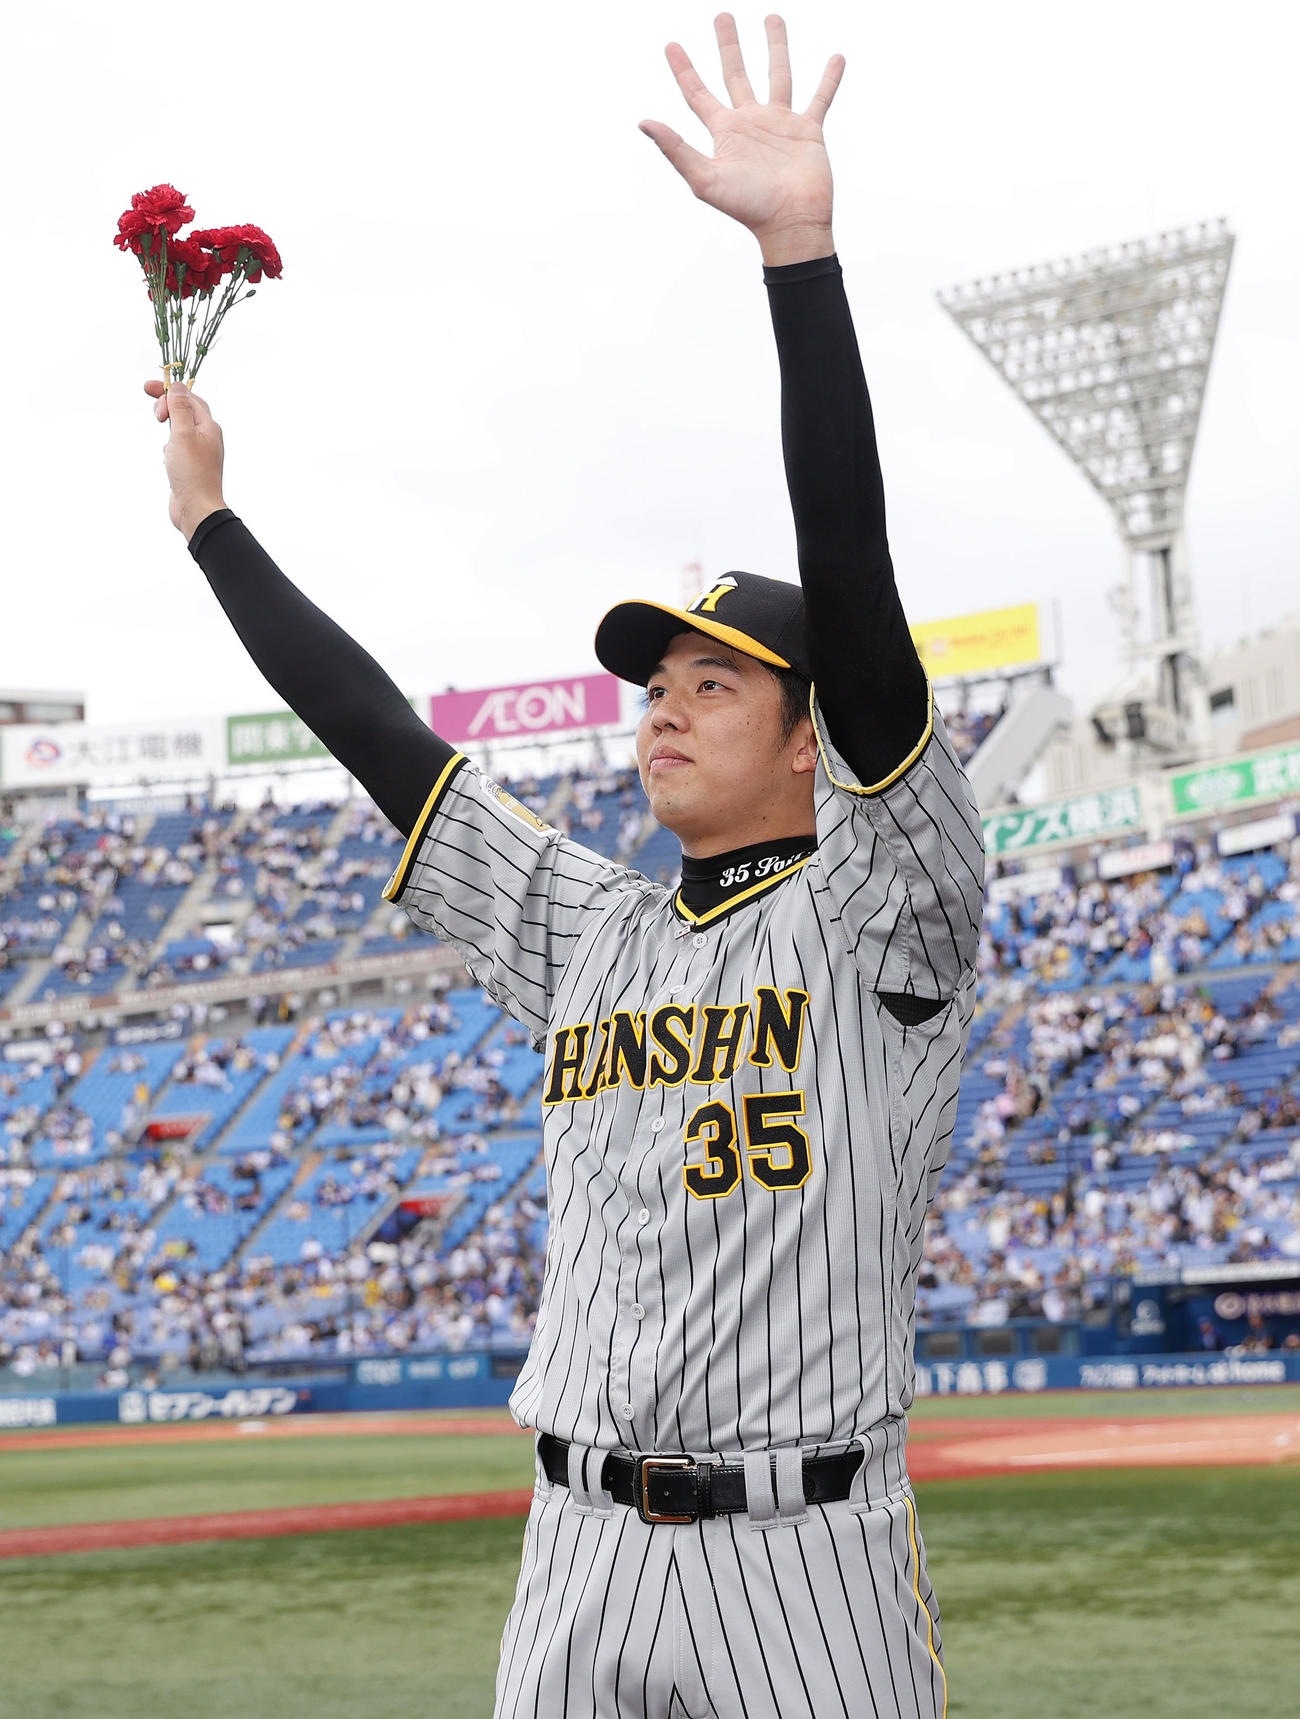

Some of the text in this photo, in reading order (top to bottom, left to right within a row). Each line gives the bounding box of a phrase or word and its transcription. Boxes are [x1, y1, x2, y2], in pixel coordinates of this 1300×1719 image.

[68, 731, 203, 767] 大江電機
[719, 861, 752, 887] 35
[683, 1090, 812, 1200] 35
